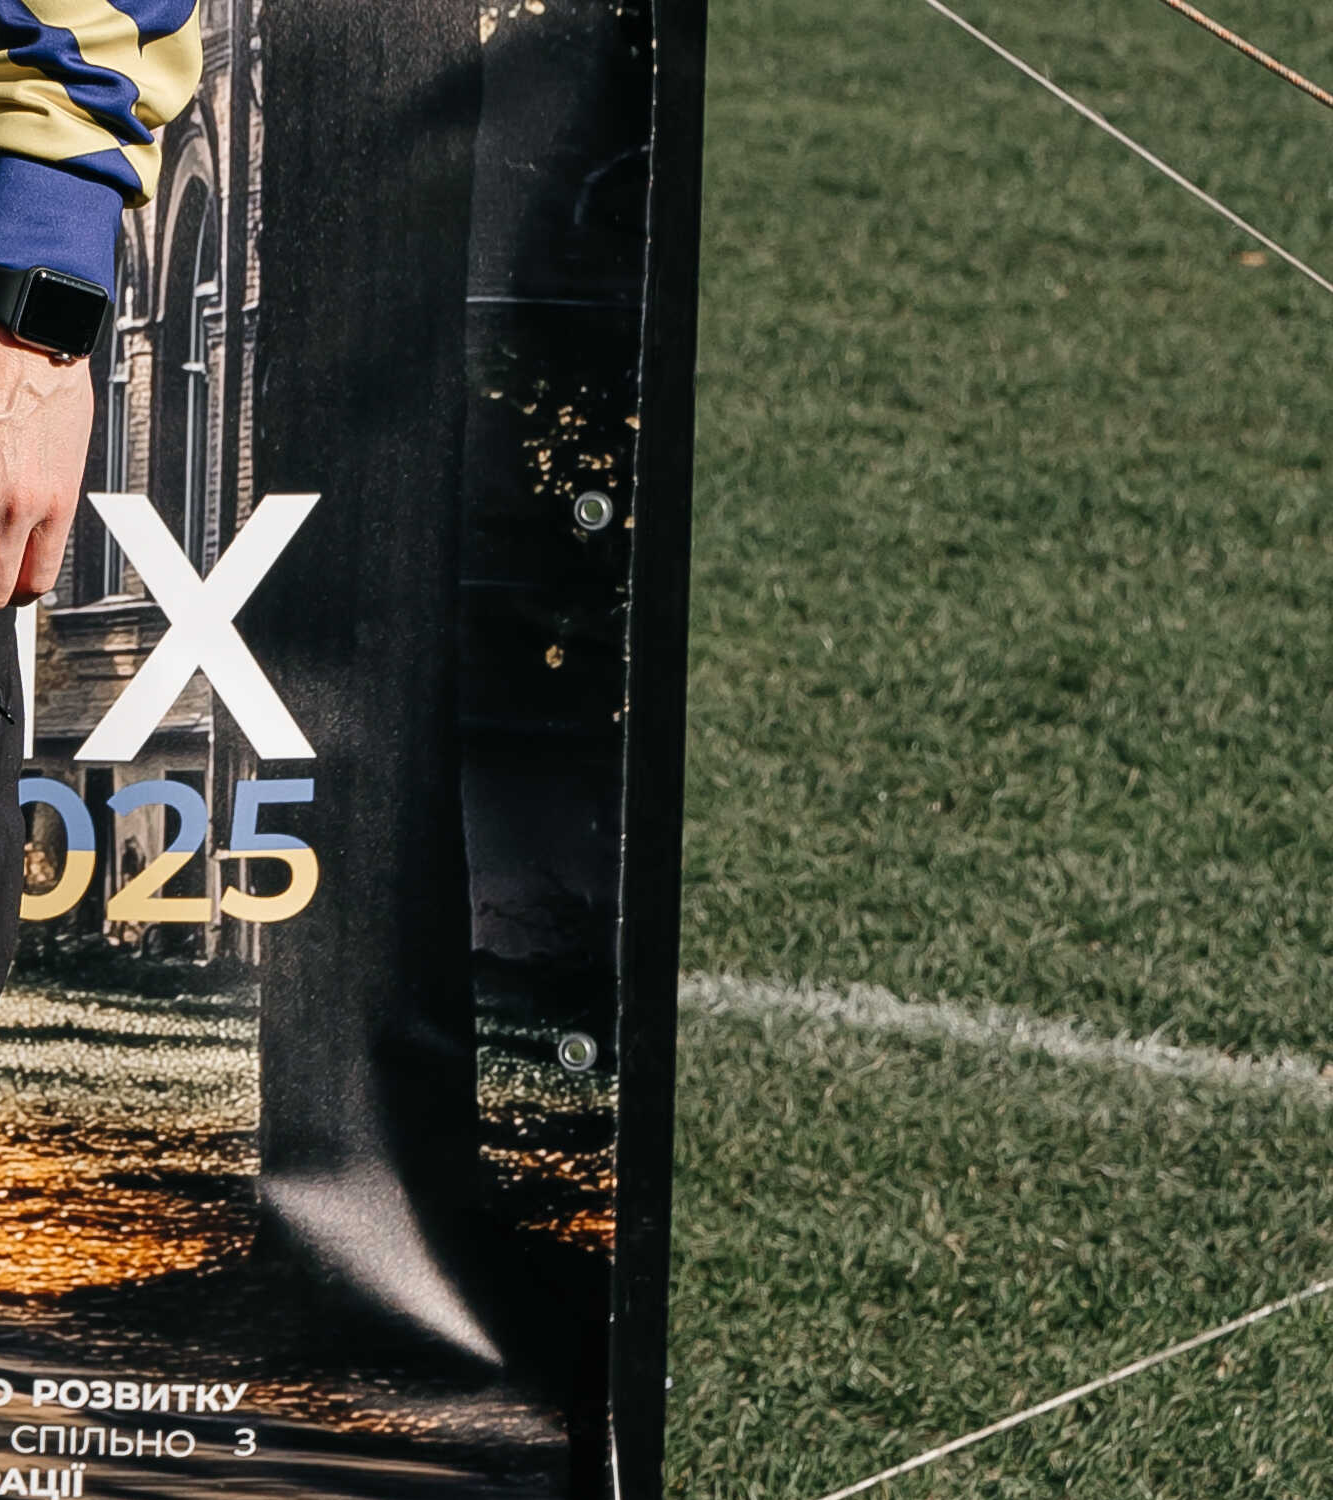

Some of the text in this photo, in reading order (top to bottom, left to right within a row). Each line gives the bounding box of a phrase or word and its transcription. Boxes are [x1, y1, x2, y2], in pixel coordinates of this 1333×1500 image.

[32, 1378, 249, 1413] РОЗВИТКУ
[10, 1424, 196, 1458] СПІЛЬНО
[233, 1428, 257, 1457] З
